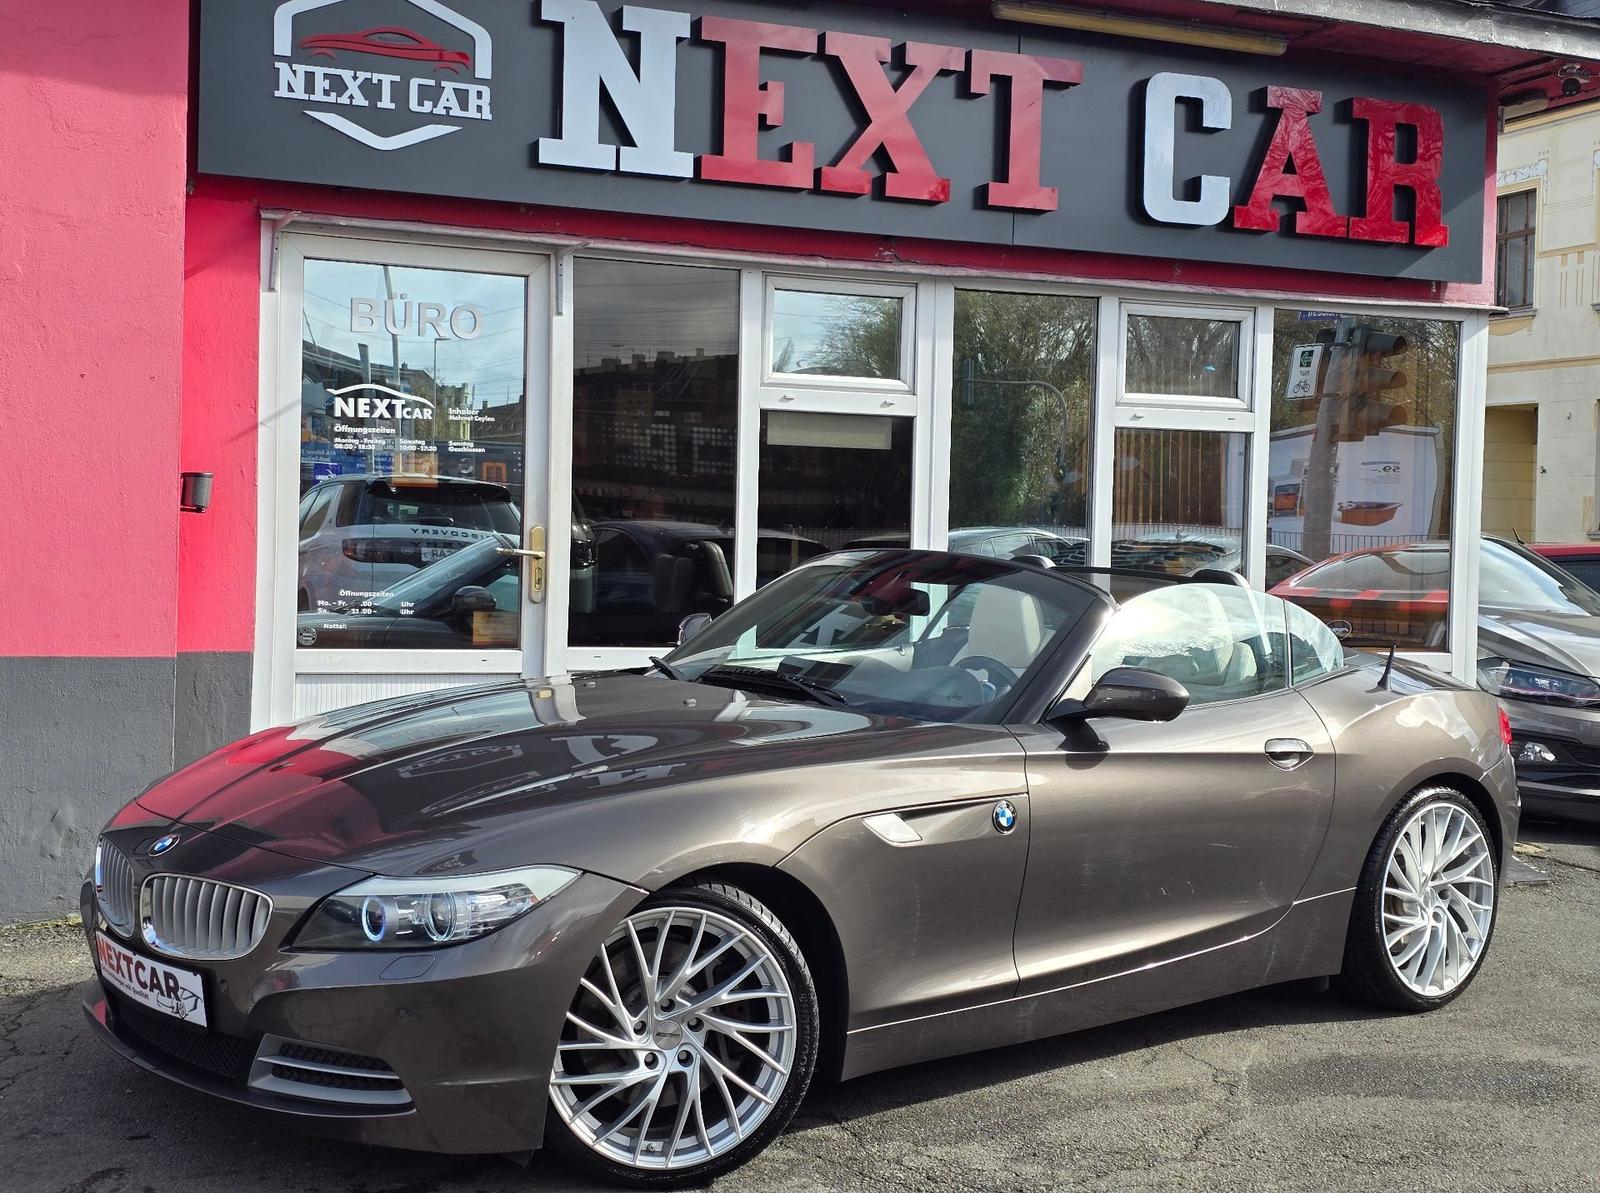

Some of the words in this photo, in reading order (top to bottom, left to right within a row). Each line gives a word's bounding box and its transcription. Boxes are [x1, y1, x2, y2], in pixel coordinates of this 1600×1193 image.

[273, 61, 401, 110] NEXT
[408, 78, 493, 121] CAR
[537, 0, 1083, 212] NEXT
[1142, 72, 1449, 248] CAR
[350, 292, 484, 341] BÜRO
[333, 424, 396, 435] Öffnungszeiten
[339, 589, 394, 598] Öffnungszeiten
